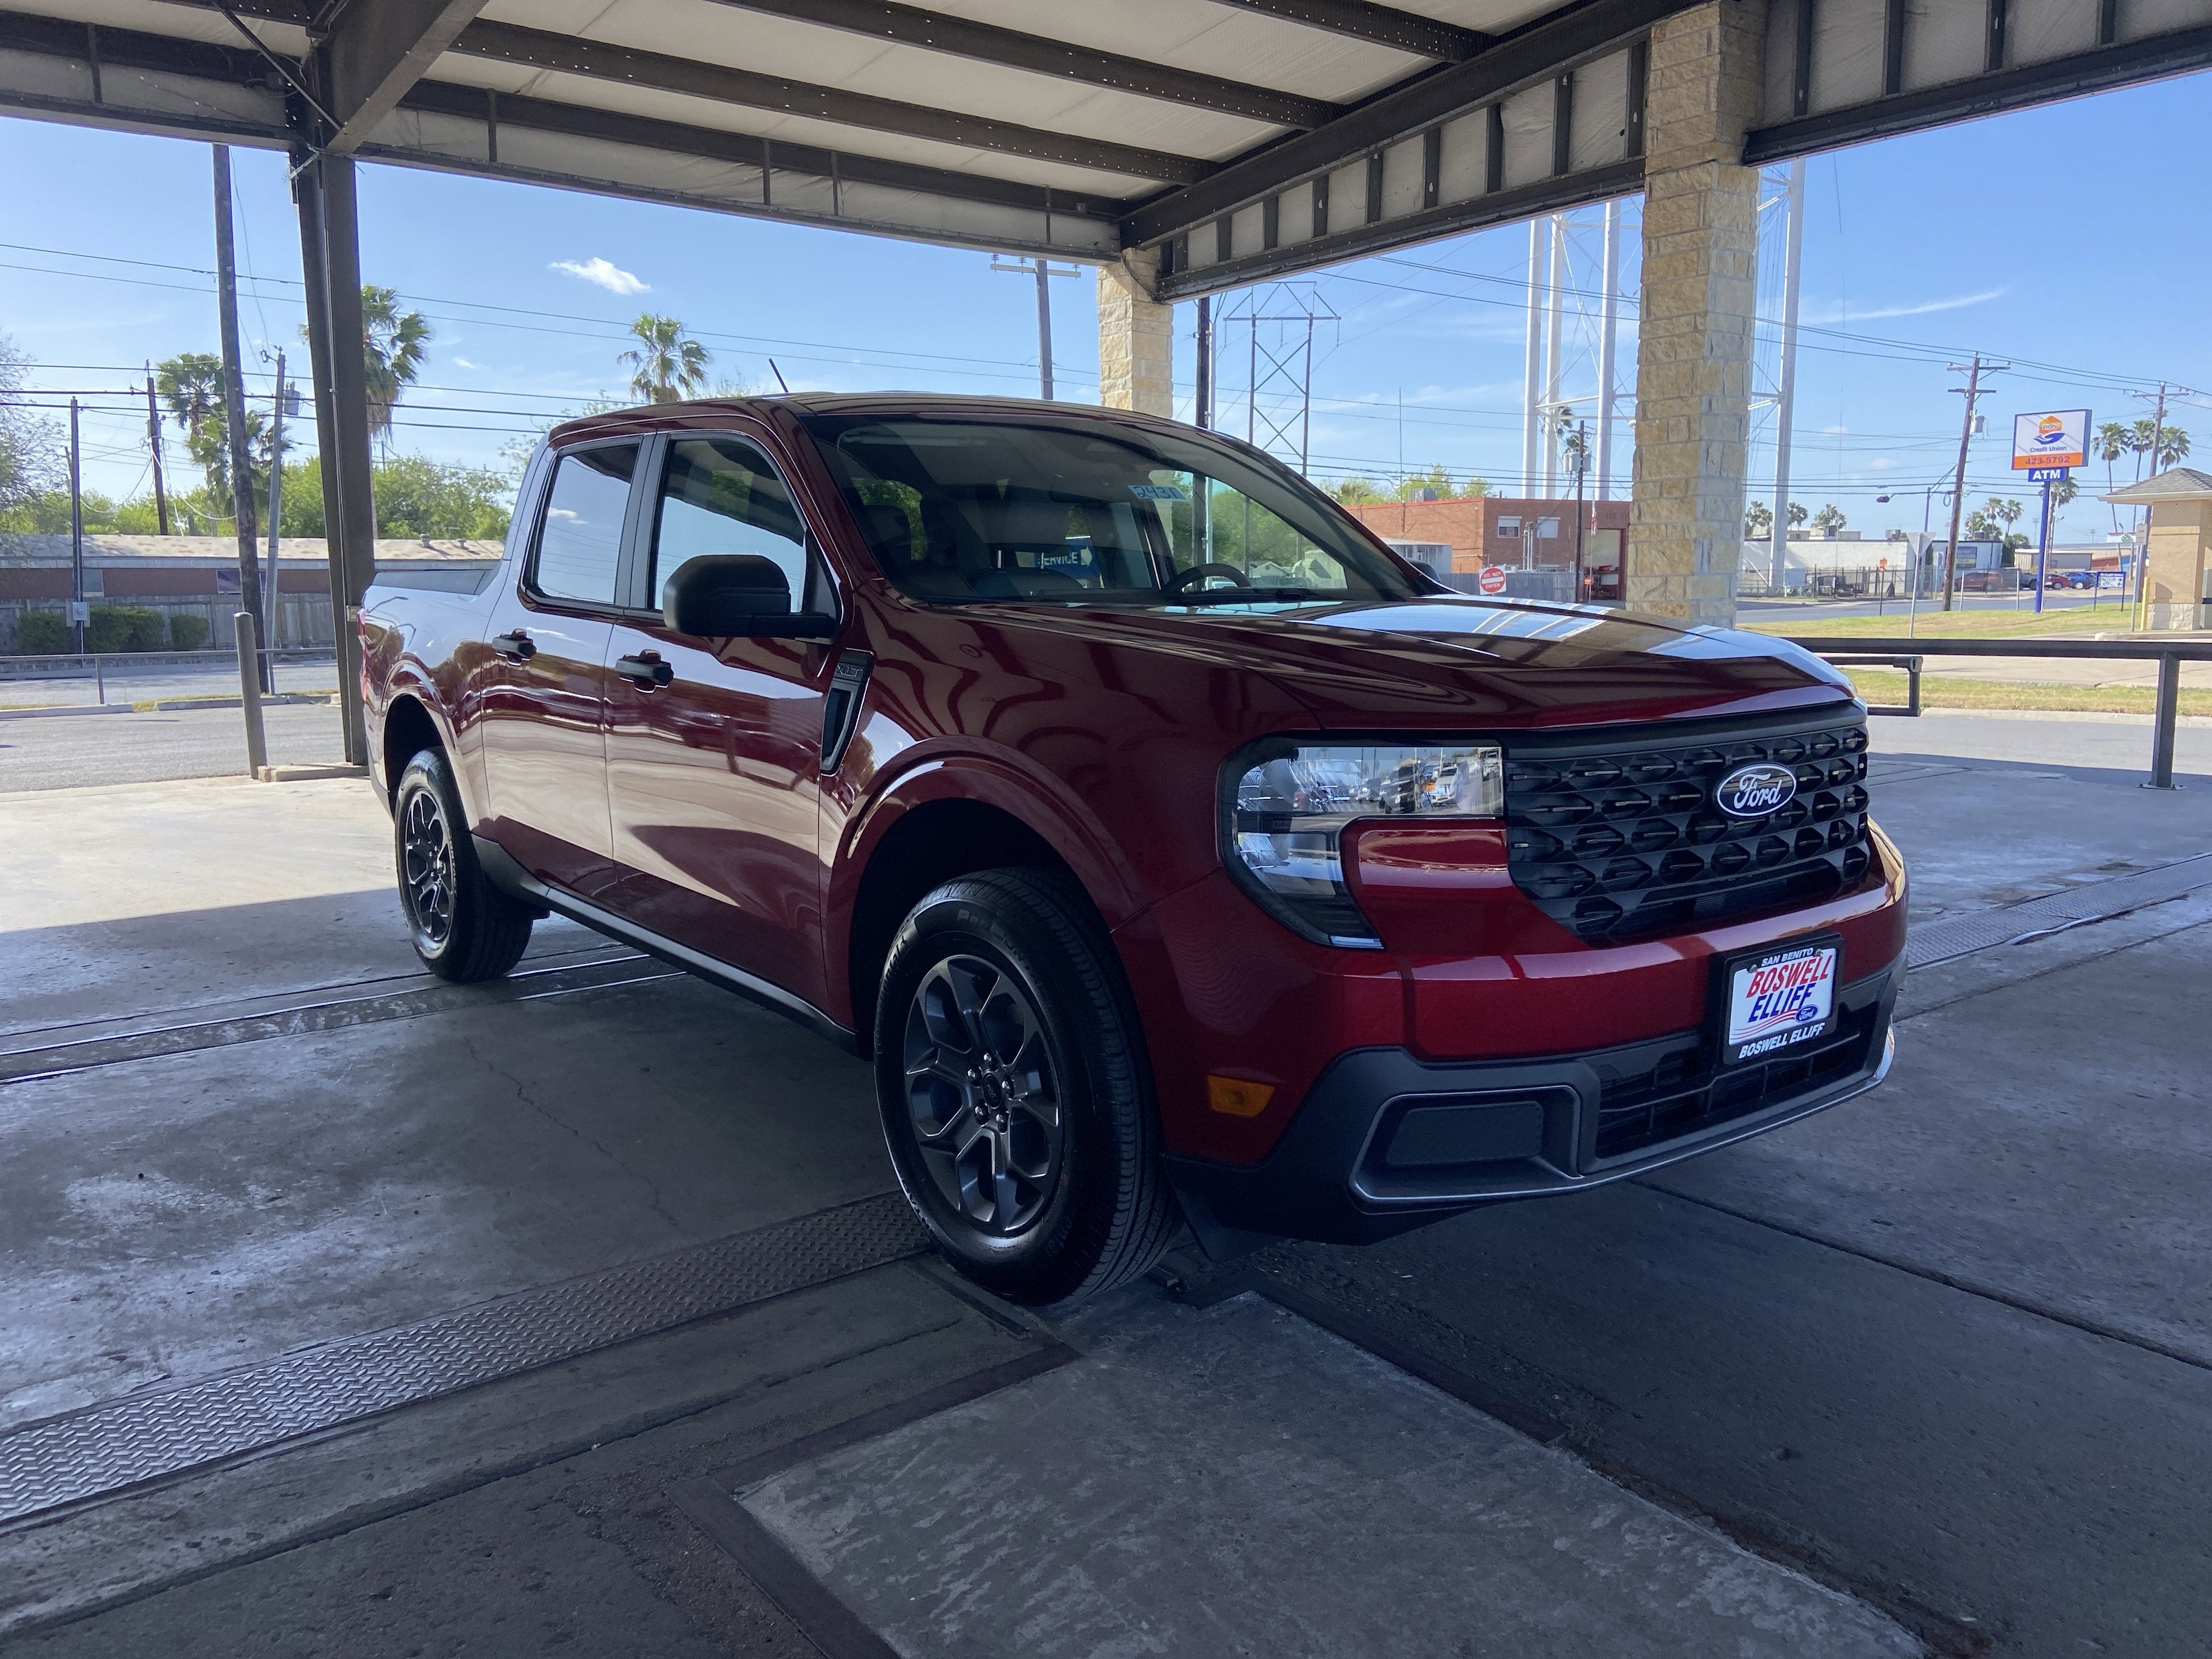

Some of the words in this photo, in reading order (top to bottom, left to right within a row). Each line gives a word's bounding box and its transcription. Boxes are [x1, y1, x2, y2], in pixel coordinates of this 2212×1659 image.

[2032, 469, 2061, 481] ATM
[1038, 552, 1078, 565] ERVICE
[834, 664, 863, 678] XLT
[1734, 773, 1782, 809] Ford
[1761, 955, 1782, 967] SAN
[1782, 947, 1814, 964] BENITO
[1746, 954, 1833, 998] BOSWELL
[1747, 983, 1816, 1024] ELLIFF
[1799, 1007, 1814, 1020] Ford
[1738, 1033, 1787, 1059] BOSWELL
[1789, 1022, 1826, 1044] ELLIFF
